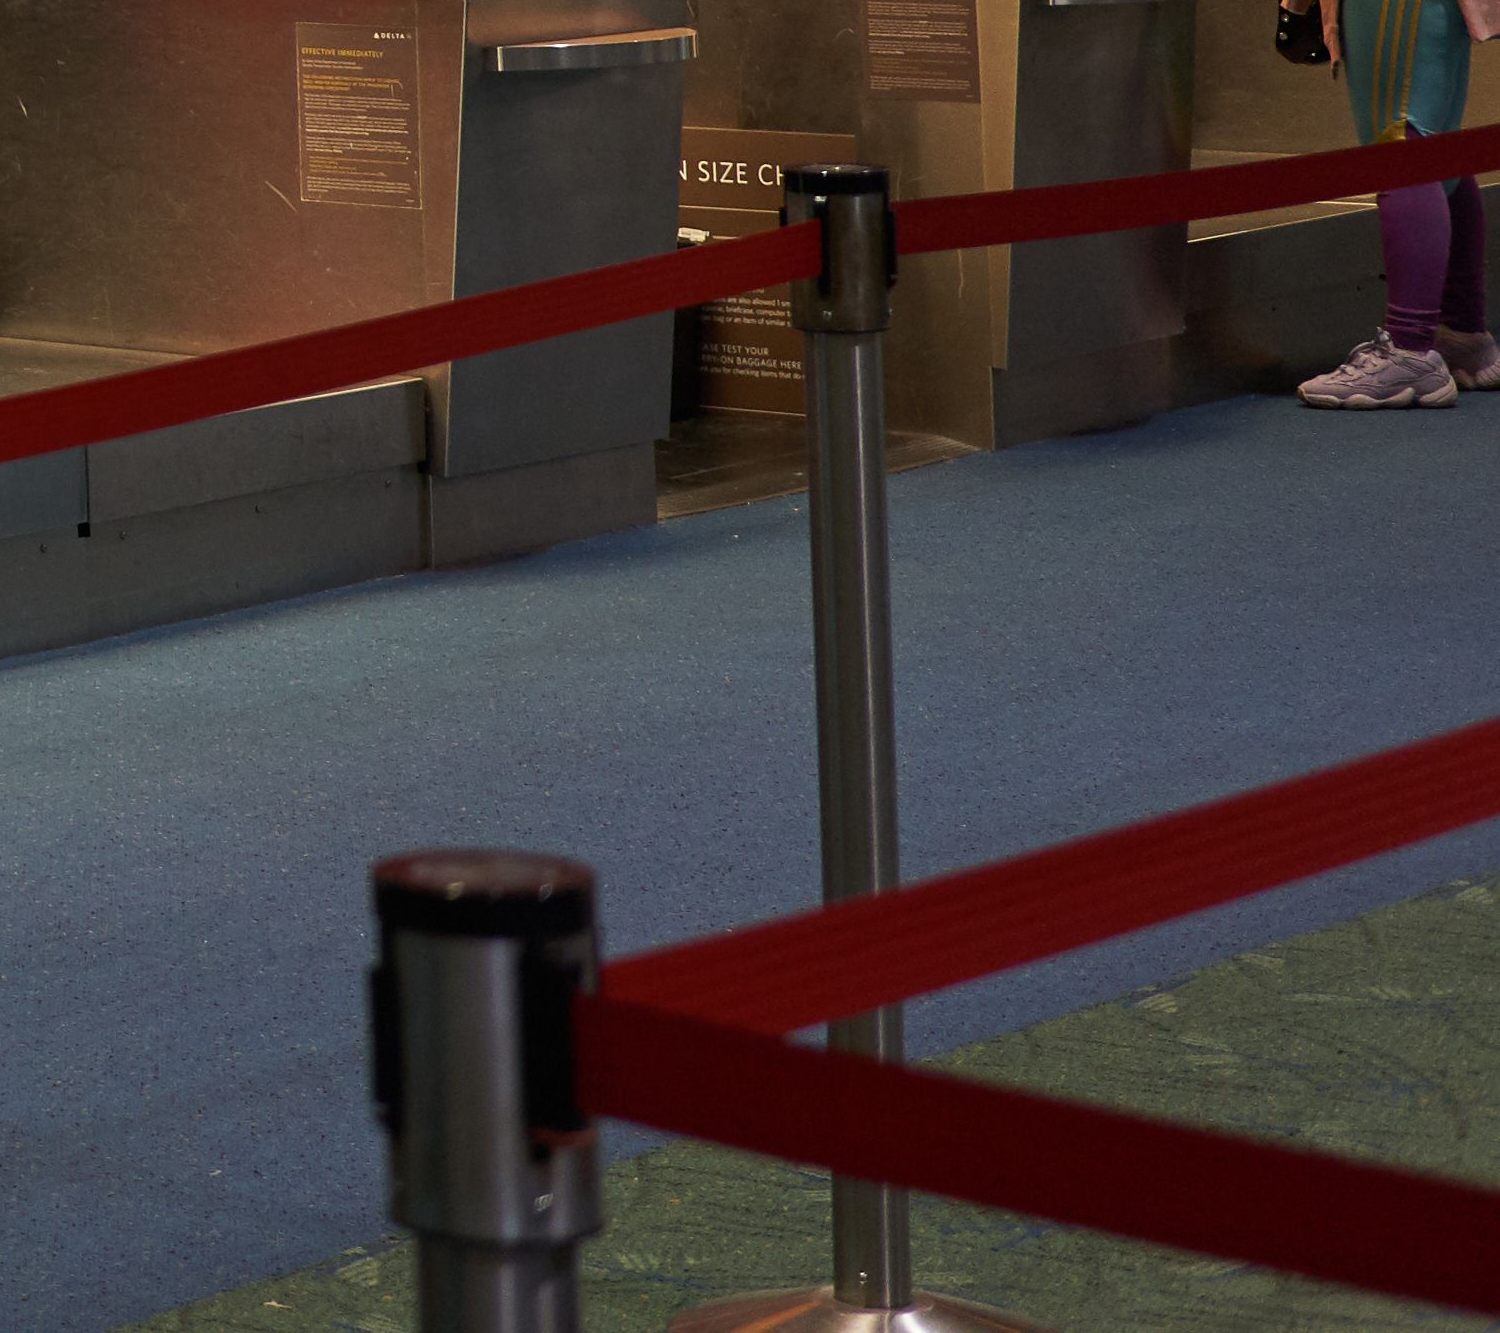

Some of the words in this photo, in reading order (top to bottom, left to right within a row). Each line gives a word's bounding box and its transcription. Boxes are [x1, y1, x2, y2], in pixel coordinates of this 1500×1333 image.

[301, 47, 336, 56] EFFECTIVE
[337, 49, 384, 58] IMMEDIATELY
[698, 160, 748, 184] SIZE
[752, 298, 776, 307] allowed
[756, 309, 785, 317] computer
[702, 343, 718, 352] ASE
[721, 344, 742, 353] TEST
[744, 346, 769, 355] YOUR
[701, 354, 734, 364] RRY-ON
[736, 357, 777, 368] BAGGAGE
[780, 360, 802, 370] HERE
[732, 367, 759, 377] checking
